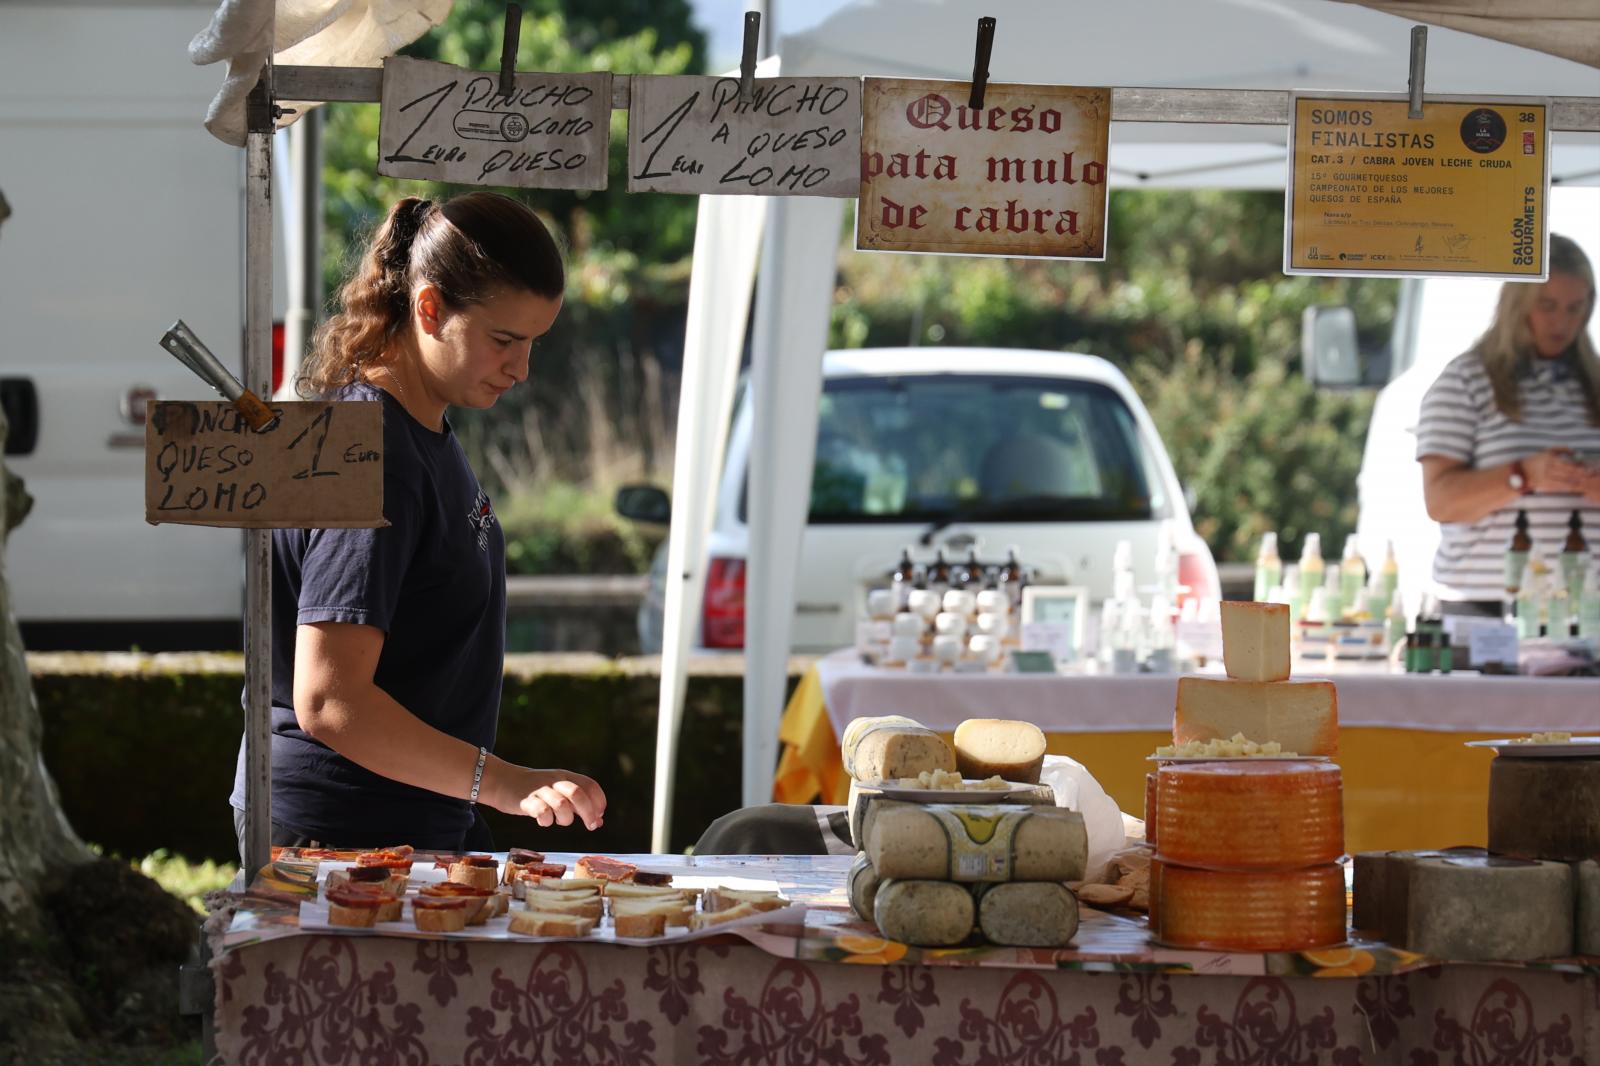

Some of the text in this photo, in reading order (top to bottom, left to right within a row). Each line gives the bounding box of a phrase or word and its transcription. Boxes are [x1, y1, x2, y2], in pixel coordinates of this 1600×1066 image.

[384, 80, 458, 164] 1
[906, 93, 1062, 134] Queso
[1311, 109, 1373, 127] SOMOS
[1519, 112, 1535, 123] 38
[634, 91, 700, 180] 1
[711, 122, 847, 158] A QUESO
[1311, 131, 1435, 149] FINALISTAS
[478, 148, 587, 181] QUESO
[719, 156, 830, 190] LOMO
[861, 148, 1105, 186] pata mulo
[1311, 155, 1344, 165] CAT.3
[1363, 156, 1395, 166] CABRA
[1402, 157, 1434, 167] JOVEN
[1441, 158, 1473, 168] LECHE
[1479, 159, 1512, 169] CRUDA
[1333, 173, 1408, 183] GOURMETQUESOS
[1309, 194, 1402, 204] QUESOS DE ESPAÑA
[1310, 184, 1454, 195] CAMPEONATO DE LOS MEJORES
[881, 196, 1080, 235] de cabra
[1523, 187, 1536, 265] GOURMETS
[1511, 218, 1524, 265] SALÓN
[156, 442, 253, 482] QUESO
[288, 406, 340, 479] 1
[158, 482, 266, 512] LOMO
